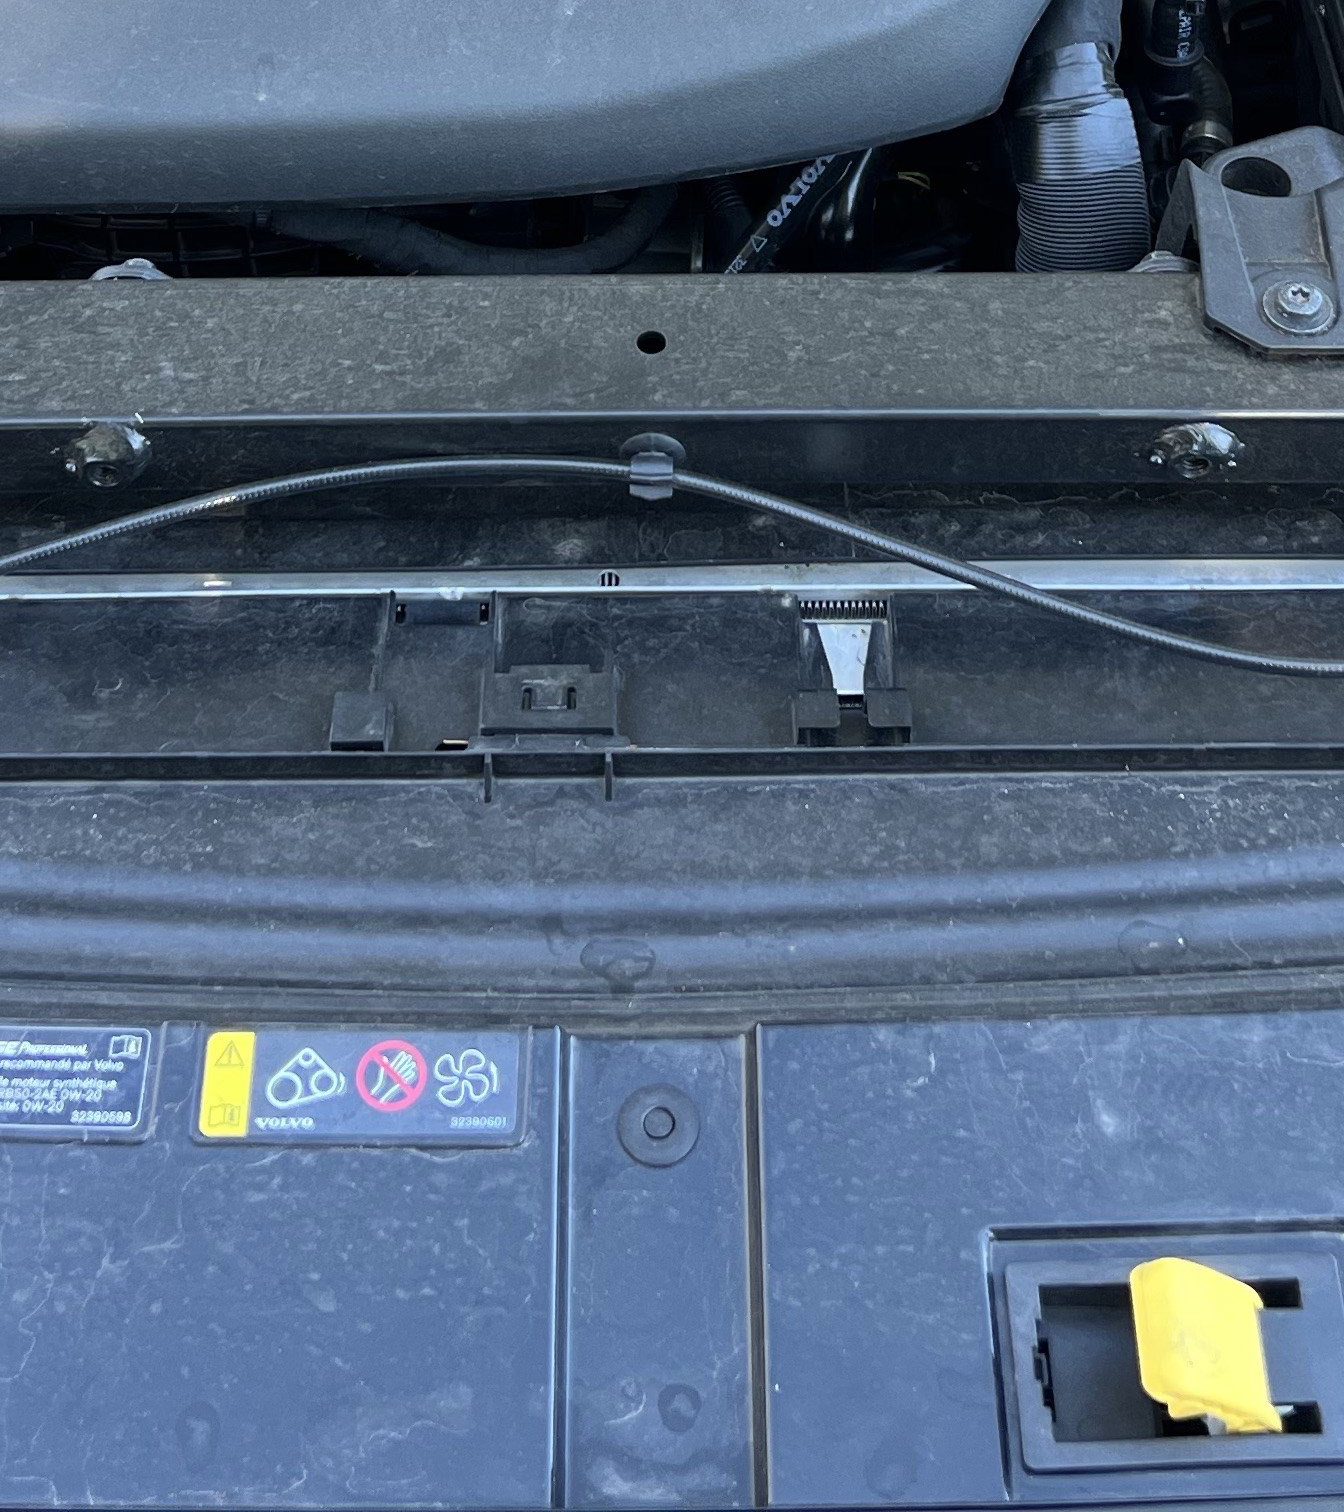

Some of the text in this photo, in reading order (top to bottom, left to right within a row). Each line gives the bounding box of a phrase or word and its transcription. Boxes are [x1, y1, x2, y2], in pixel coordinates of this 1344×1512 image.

[766, 154, 836, 227] VOLVO
[73, 1061, 91, 1073] par
[94, 1059, 125, 1072] Volvo
[11, 1077, 51, 1089] moteur
[255, 1117, 315, 1130] VOLVO
